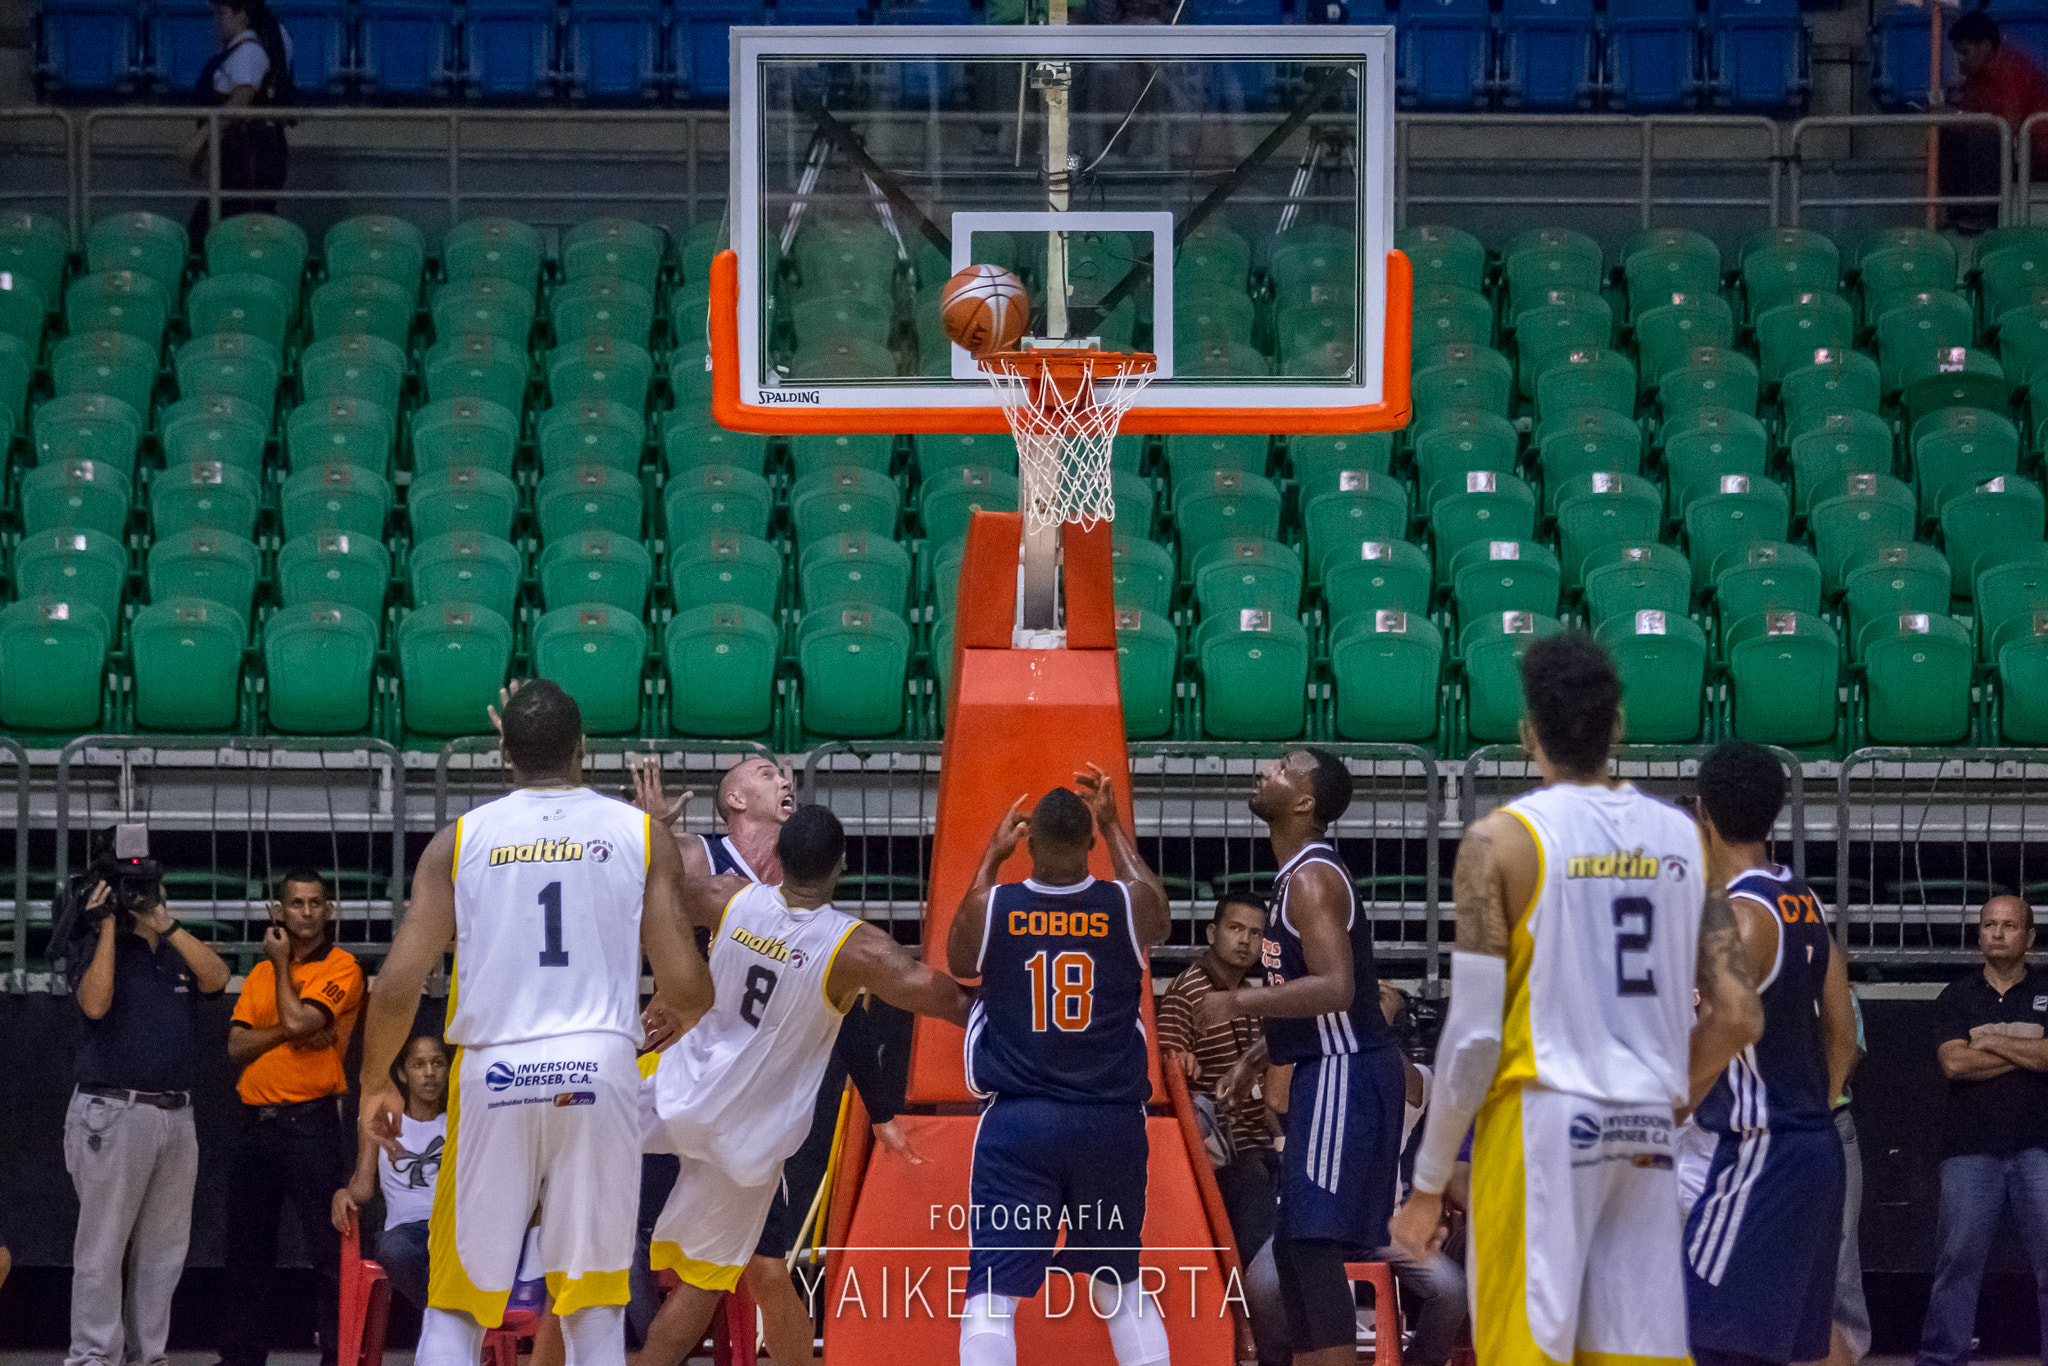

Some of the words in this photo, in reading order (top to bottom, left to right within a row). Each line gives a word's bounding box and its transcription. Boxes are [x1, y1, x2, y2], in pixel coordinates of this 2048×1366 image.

[758, 391, 820, 405] SPALDING
[489, 836, 584, 867] maltín
[537, 882, 570, 967] 1
[1008, 910, 1110, 937] COBOS
[731, 926, 790, 964] malín
[1611, 896, 1658, 997] 2
[322, 981, 346, 1005] 109
[739, 964, 779, 1030] 8
[1024, 950, 1095, 1033] 18
[515, 1074, 565, 1087] DERSEB,
[569, 1073, 592, 1085] C.A.
[517, 1061, 598, 1075] INVERSIONES
